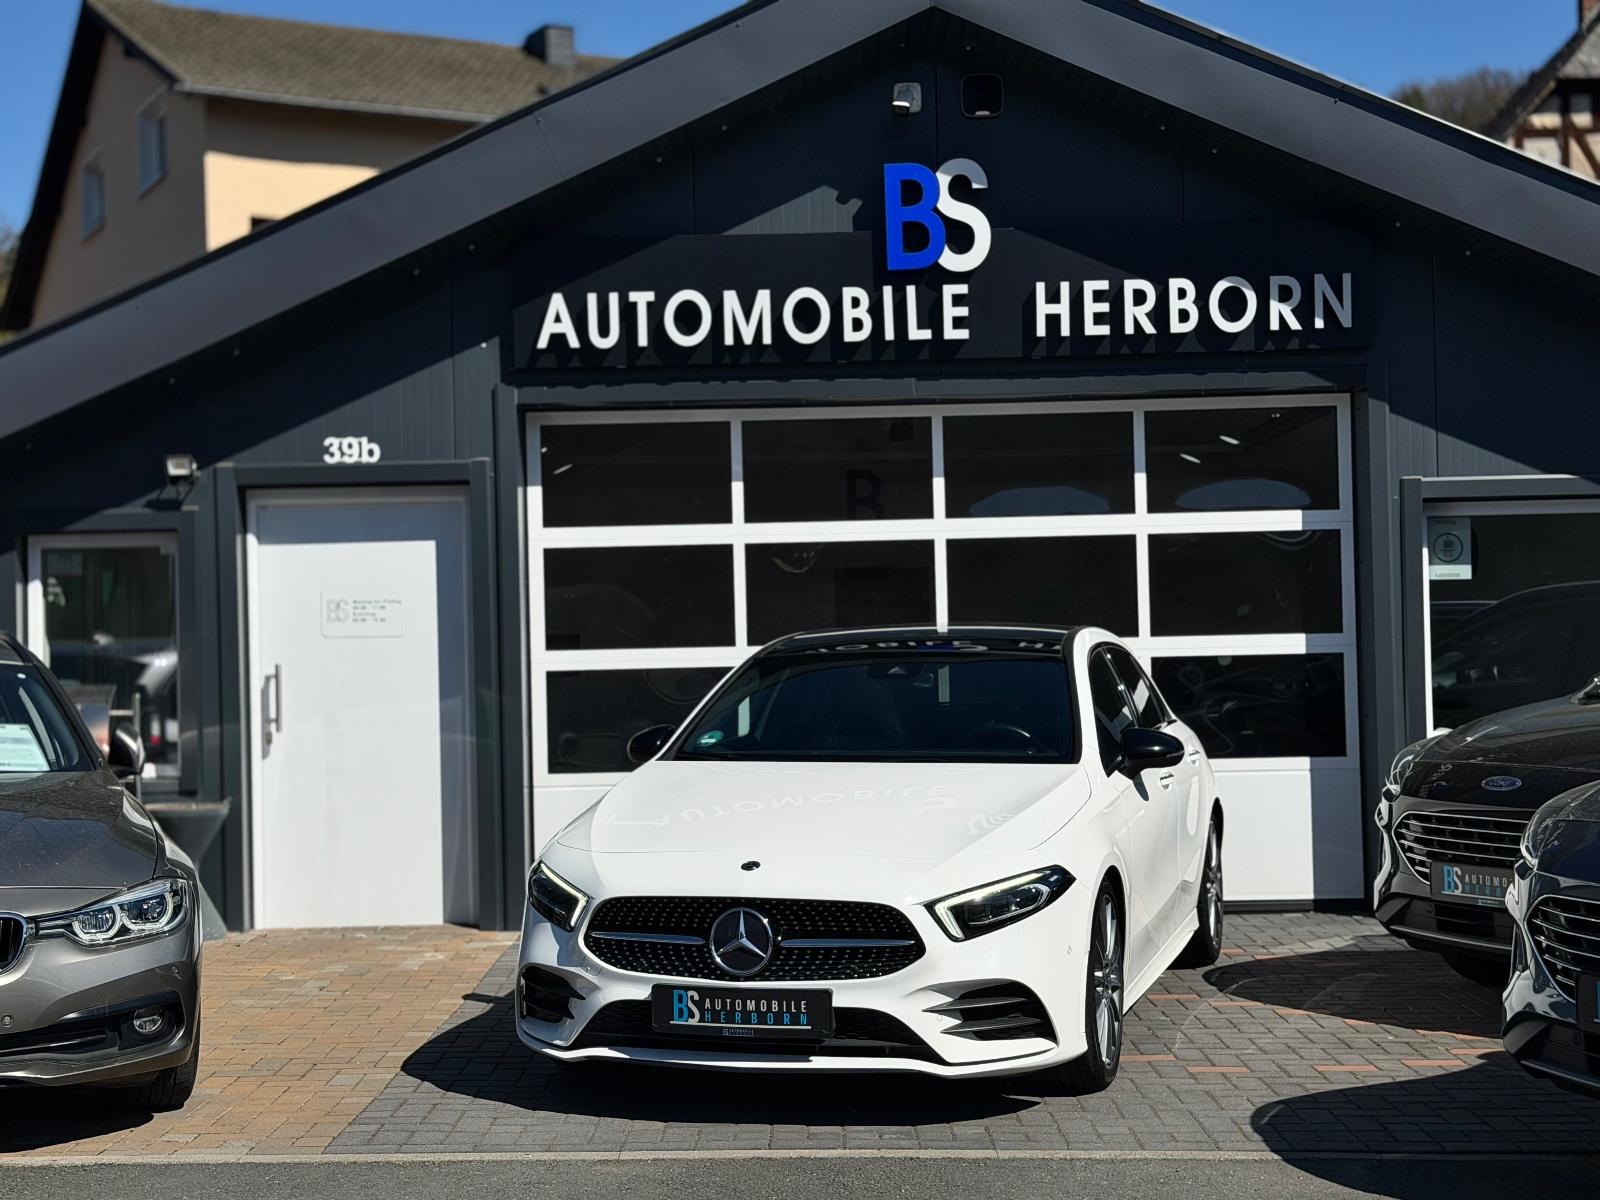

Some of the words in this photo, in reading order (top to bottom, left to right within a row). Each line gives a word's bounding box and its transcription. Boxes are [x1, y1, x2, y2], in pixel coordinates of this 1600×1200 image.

[883, 158, 992, 272] BS
[536, 284, 970, 349] AUTOMOBILE
[1035, 272, 1353, 338] HERBORN
[323, 436, 381, 464] 39b
[1443, 865, 1463, 895] BS
[1465, 873, 1512, 888] AUTOMO
[673, 989, 701, 1024] BS
[705, 998, 808, 1013] AUTOMOBILE
[705, 1010, 808, 1025] HERBORN
